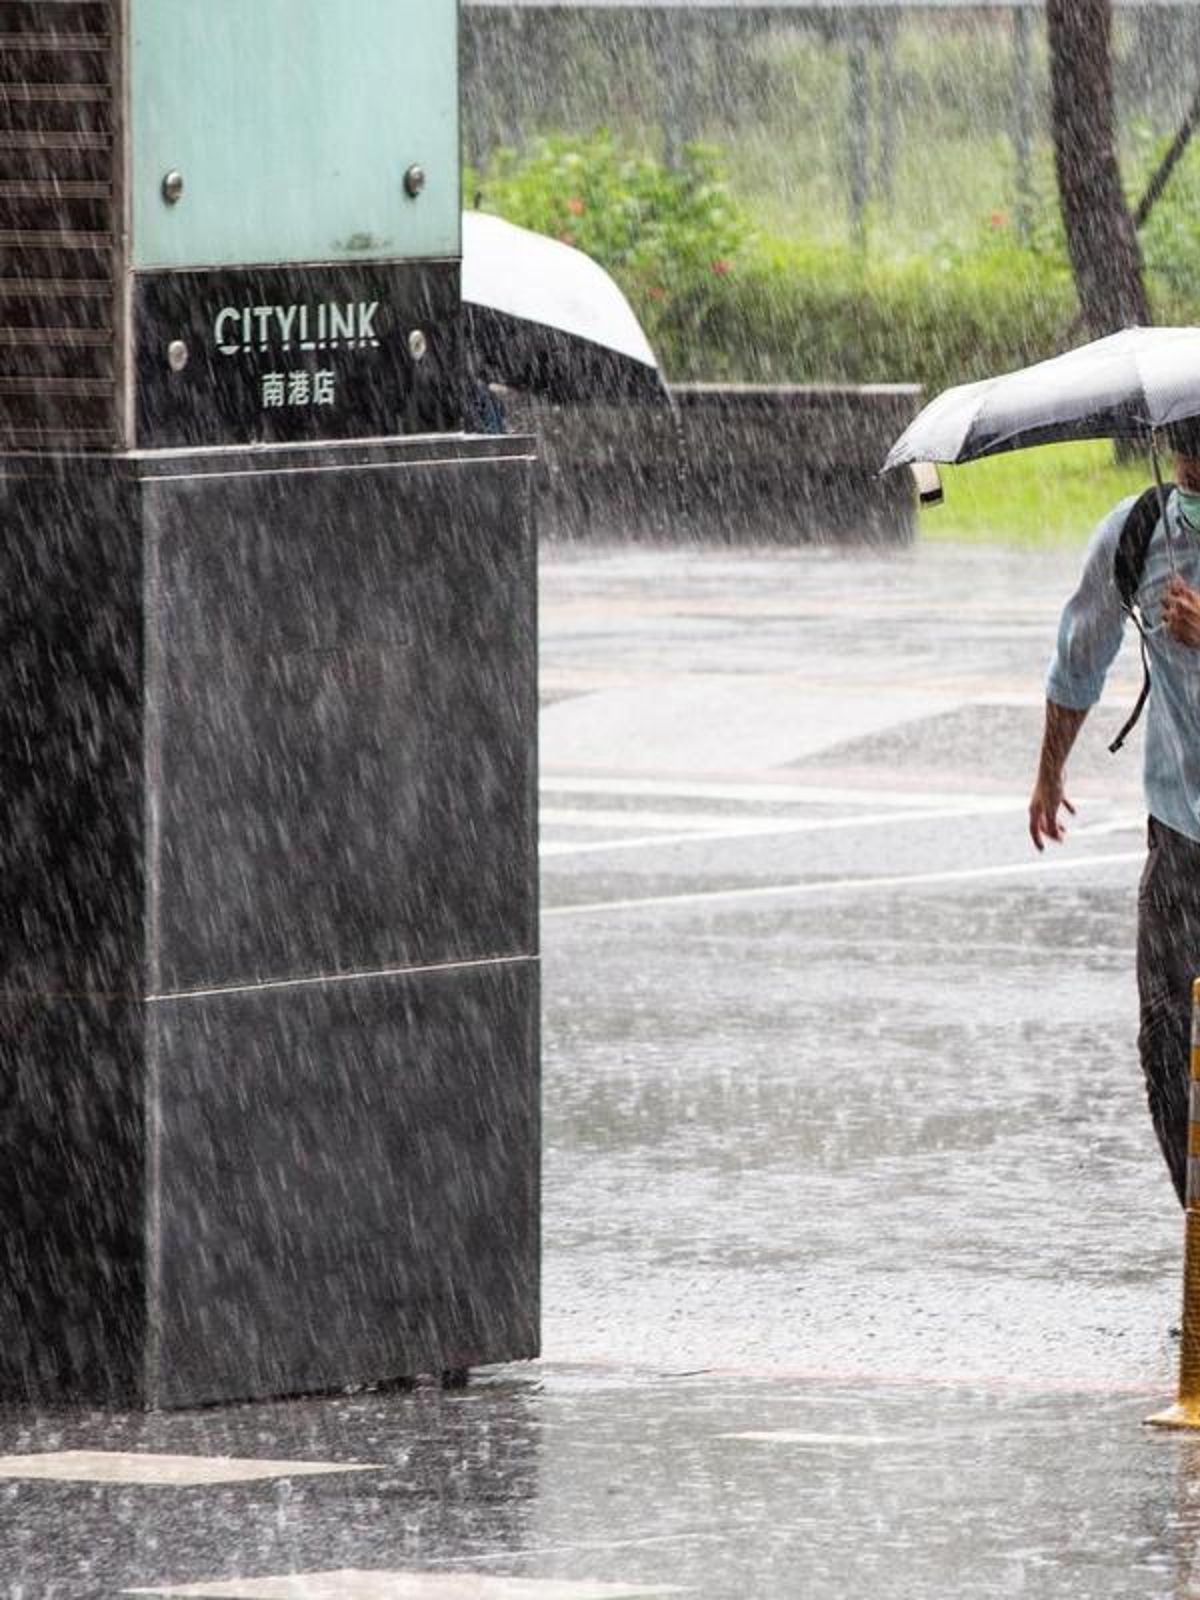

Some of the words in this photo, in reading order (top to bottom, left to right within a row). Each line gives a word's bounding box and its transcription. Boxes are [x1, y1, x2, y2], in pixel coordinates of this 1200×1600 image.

[215, 302, 380, 354] CITYLINK
[262, 370, 336, 408] 南港店
